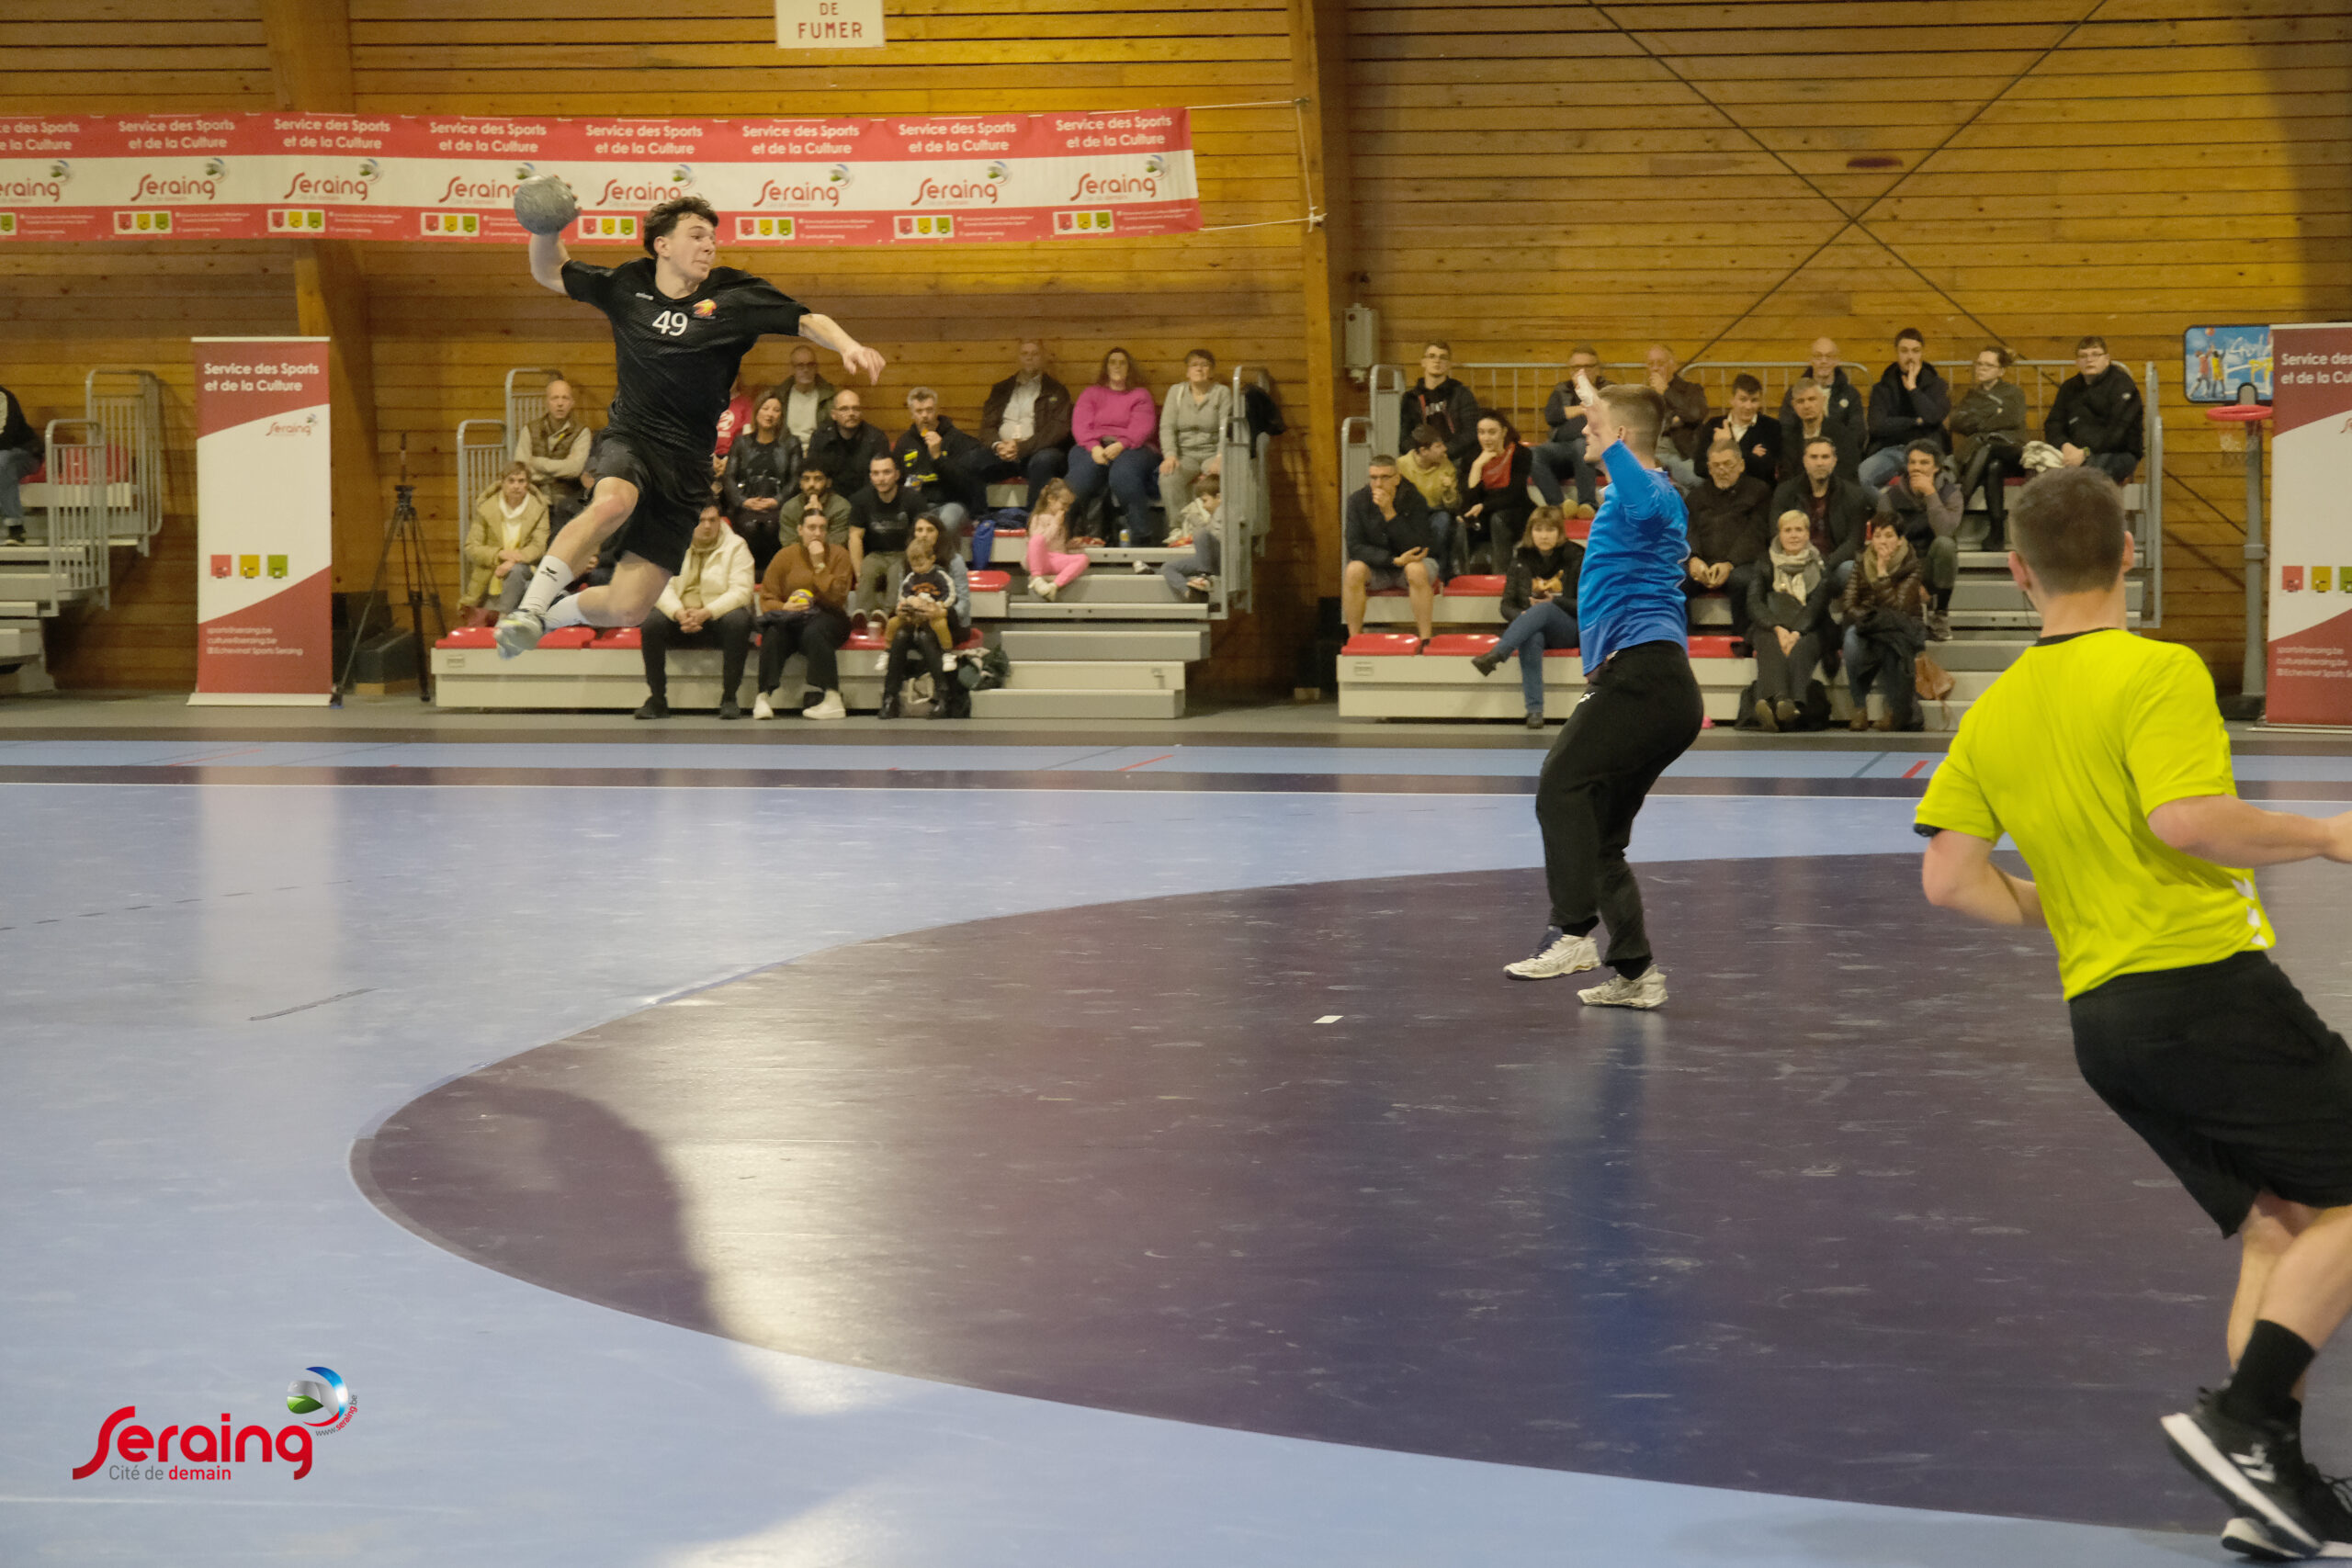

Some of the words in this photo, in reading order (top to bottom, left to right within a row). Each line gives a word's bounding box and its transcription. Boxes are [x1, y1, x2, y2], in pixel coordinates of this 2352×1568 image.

[820, 3, 839, 16] DE
[797, 22, 862, 39] FUMER
[14, 122, 39, 133] des
[40, 121, 80, 135] Sports
[119, 120, 166, 132] Service
[169, 119, 193, 131] des
[196, 119, 235, 133] Sports
[274, 118, 322, 131] Service
[324, 119, 348, 131] des
[351, 119, 390, 133] Sports
[430, 122, 478, 134] Service
[481, 122, 504, 135] des
[507, 123, 547, 138] Sports
[899, 123, 946, 136] Service
[951, 122, 975, 135] des
[978, 121, 1017, 136] Sports
[1056, 119, 1104, 132] Service
[1108, 118, 1132, 130] des
[1135, 116, 1172, 130] Sports
[585, 125, 633, 138] Service
[637, 125, 661, 138] des
[663, 125, 703, 139] Sports
[742, 125, 790, 138] Service
[793, 125, 817, 138] des
[820, 124, 860, 139] Sports
[9, 139, 22, 151] la
[25, 138, 73, 151] Culture
[129, 138, 141, 150] et
[144, 137, 162, 149] de
[165, 137, 178, 149] la
[181, 137, 227, 149] Culture
[283, 136, 296, 148] et
[300, 136, 317, 148] de
[321, 137, 333, 148] la
[335, 137, 382, 149] Culture
[439, 140, 452, 152] et
[455, 140, 472, 152] de
[476, 141, 489, 152] la
[491, 141, 538, 153] Culture
[909, 141, 922, 153] et
[925, 141, 943, 152] de
[946, 141, 959, 152] la
[962, 140, 1009, 152] Culture
[1066, 137, 1080, 148] et
[1082, 136, 1100, 148] de
[1103, 135, 1116, 147] la
[1119, 133, 1166, 146] Culture
[595, 142, 608, 154] et
[611, 142, 628, 154] de
[632, 142, 645, 154] la
[648, 142, 695, 154] Culture
[752, 142, 765, 154] et
[768, 142, 786, 154] de
[789, 142, 802, 154] la
[805, 142, 852, 154] Culture
[0, 177, 60, 202] raing
[130, 174, 216, 202] Seraing
[283, 172, 368, 200] Seraing
[752, 179, 839, 207] Seraing
[910, 177, 998, 206] Seraing
[1069, 173, 1156, 201] Seraing
[651, 310, 688, 336] 49
[2281, 353, 2328, 366] Service
[204, 363, 252, 375] Service
[254, 363, 278, 375] des
[280, 363, 320, 377] Sports
[2280, 371, 2295, 384] et
[2296, 371, 2314, 384] de
[2317, 371, 2330, 384] la
[204, 379, 218, 391] et
[220, 379, 238, 391] de
[241, 379, 254, 391] la
[256, 379, 303, 391] Culture
